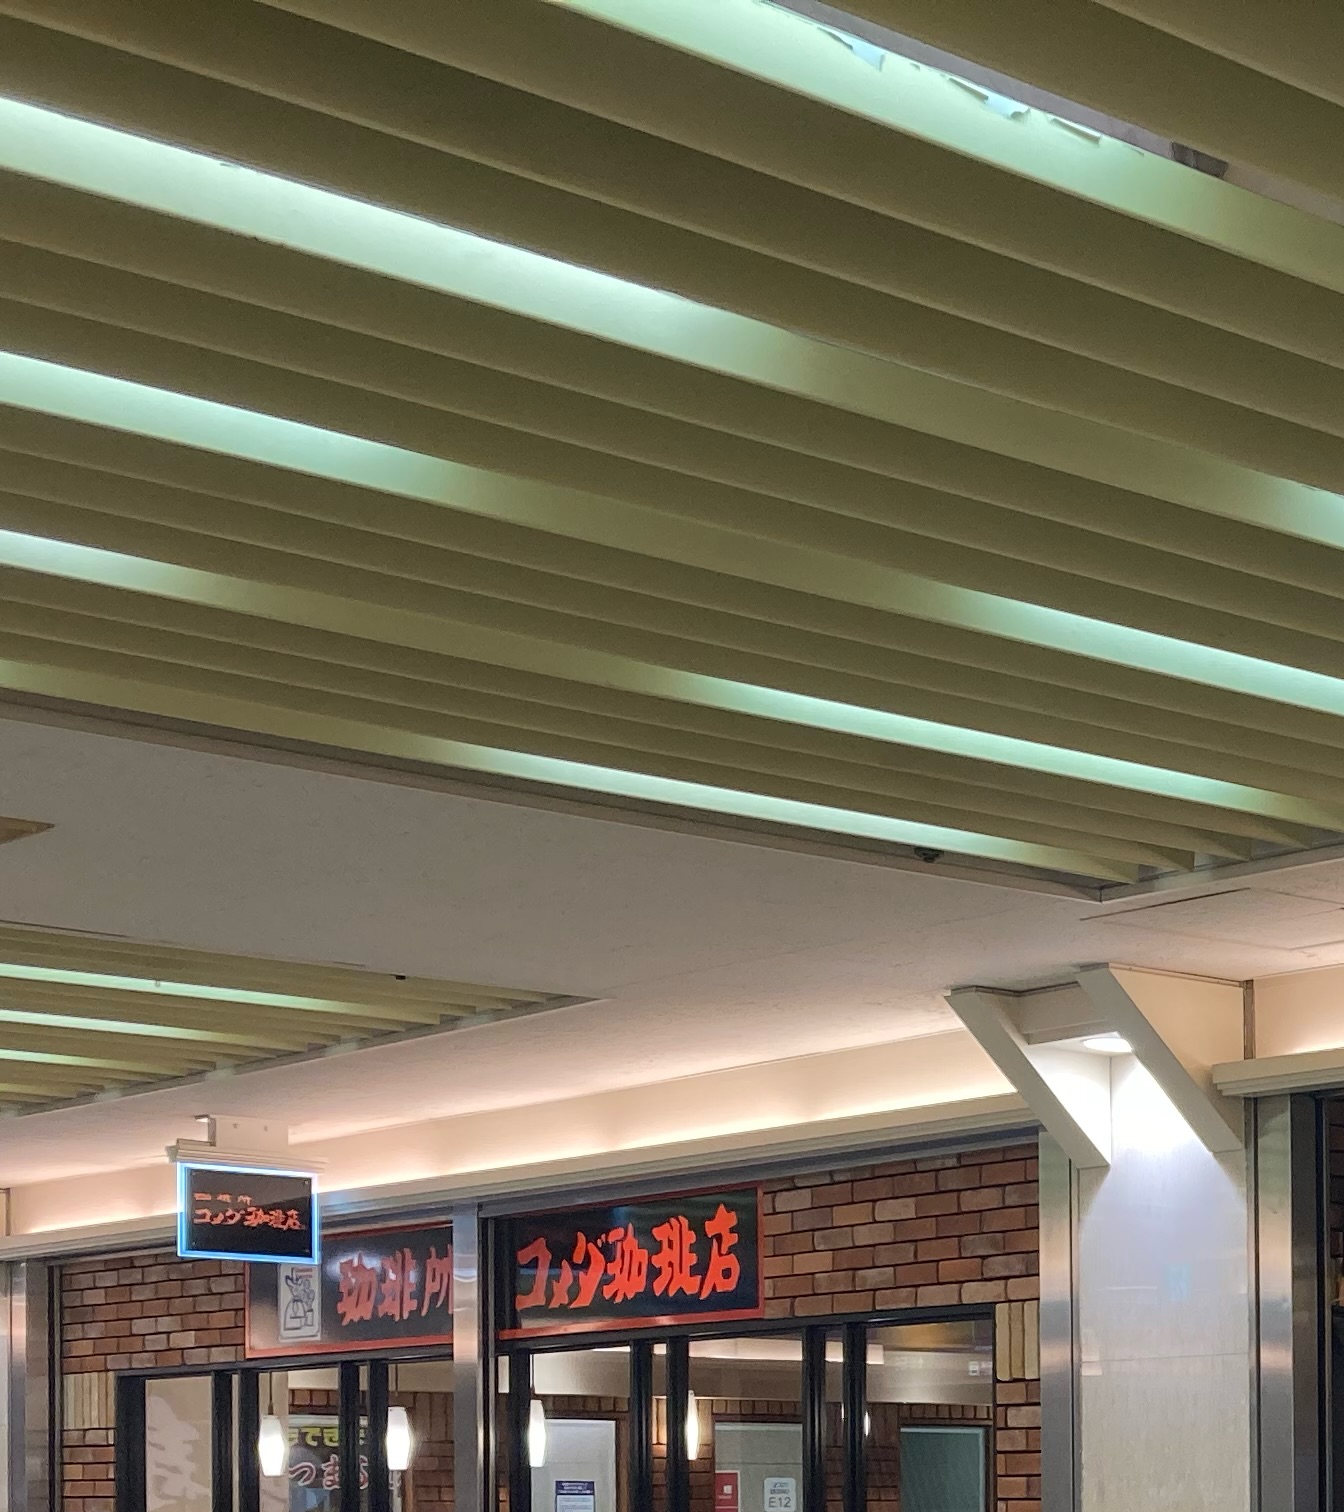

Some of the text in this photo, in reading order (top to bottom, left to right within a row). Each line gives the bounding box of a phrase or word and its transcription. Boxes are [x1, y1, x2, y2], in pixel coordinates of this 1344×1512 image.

[515, 1203, 741, 1312] コメダ珈琲店
[768, 1496, 792, 1508] E12
